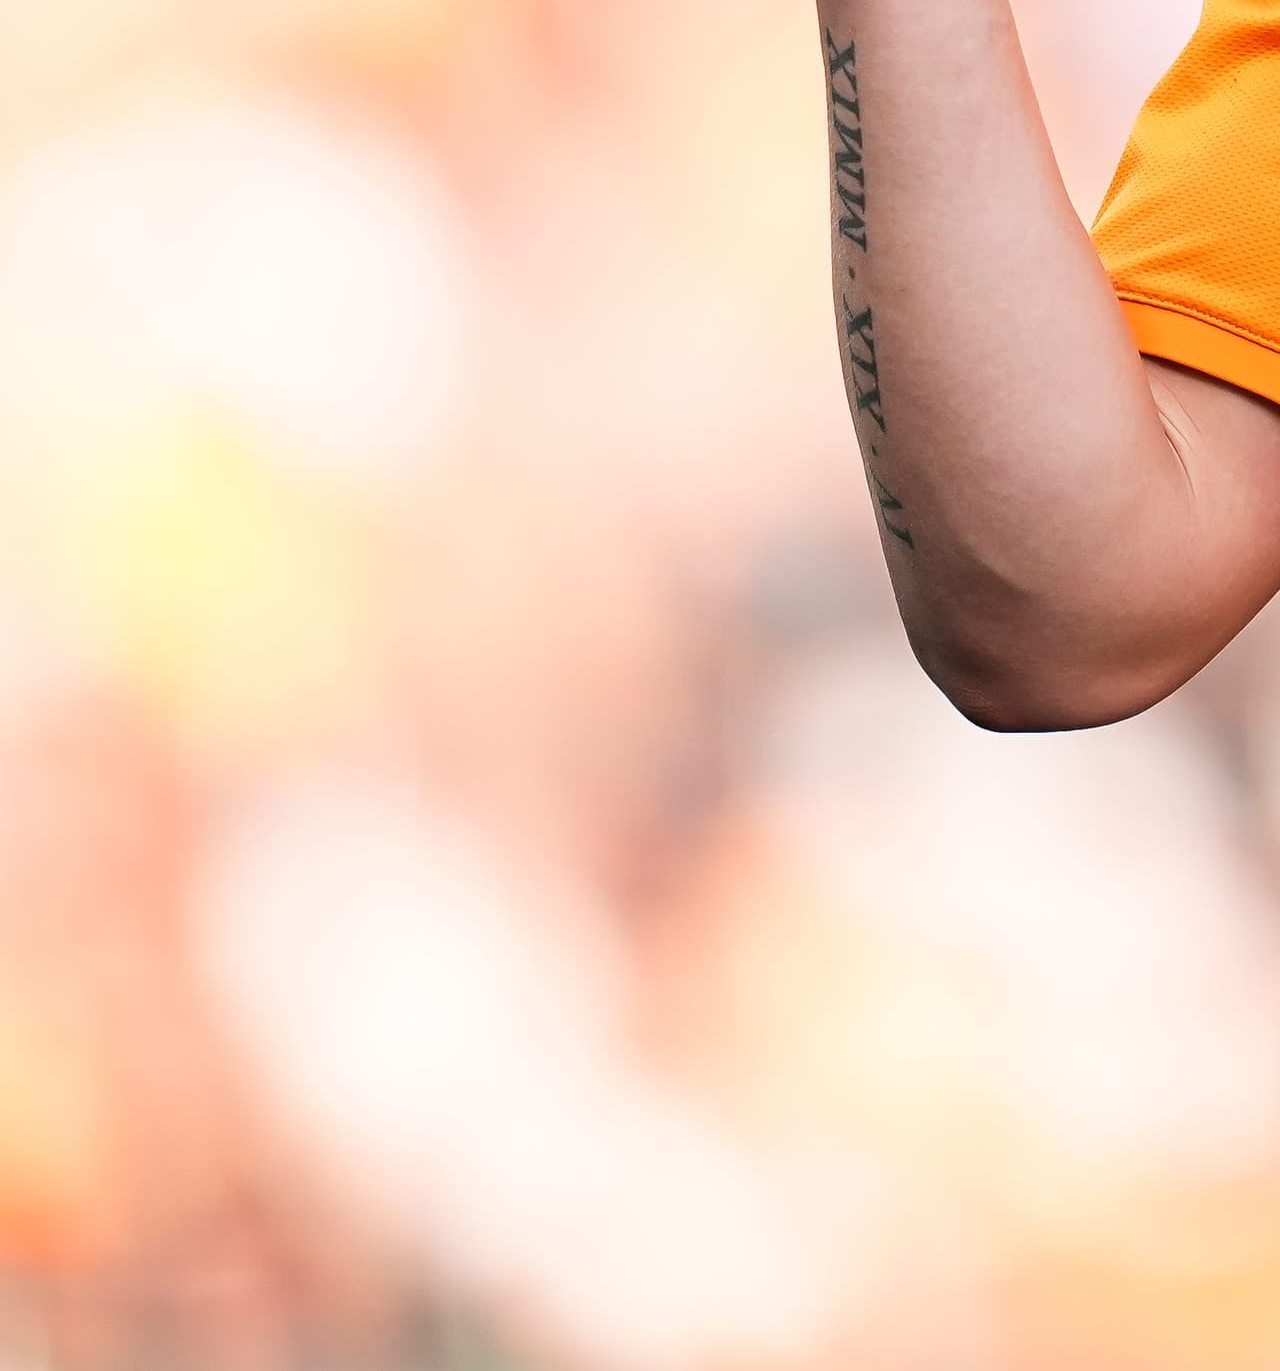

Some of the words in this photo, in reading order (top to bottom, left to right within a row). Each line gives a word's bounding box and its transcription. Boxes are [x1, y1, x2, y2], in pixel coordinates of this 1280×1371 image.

[824, 26, 868, 254] MMIX
[842, 291, 888, 434] XIX
[869, 462, 916, 551] IV
